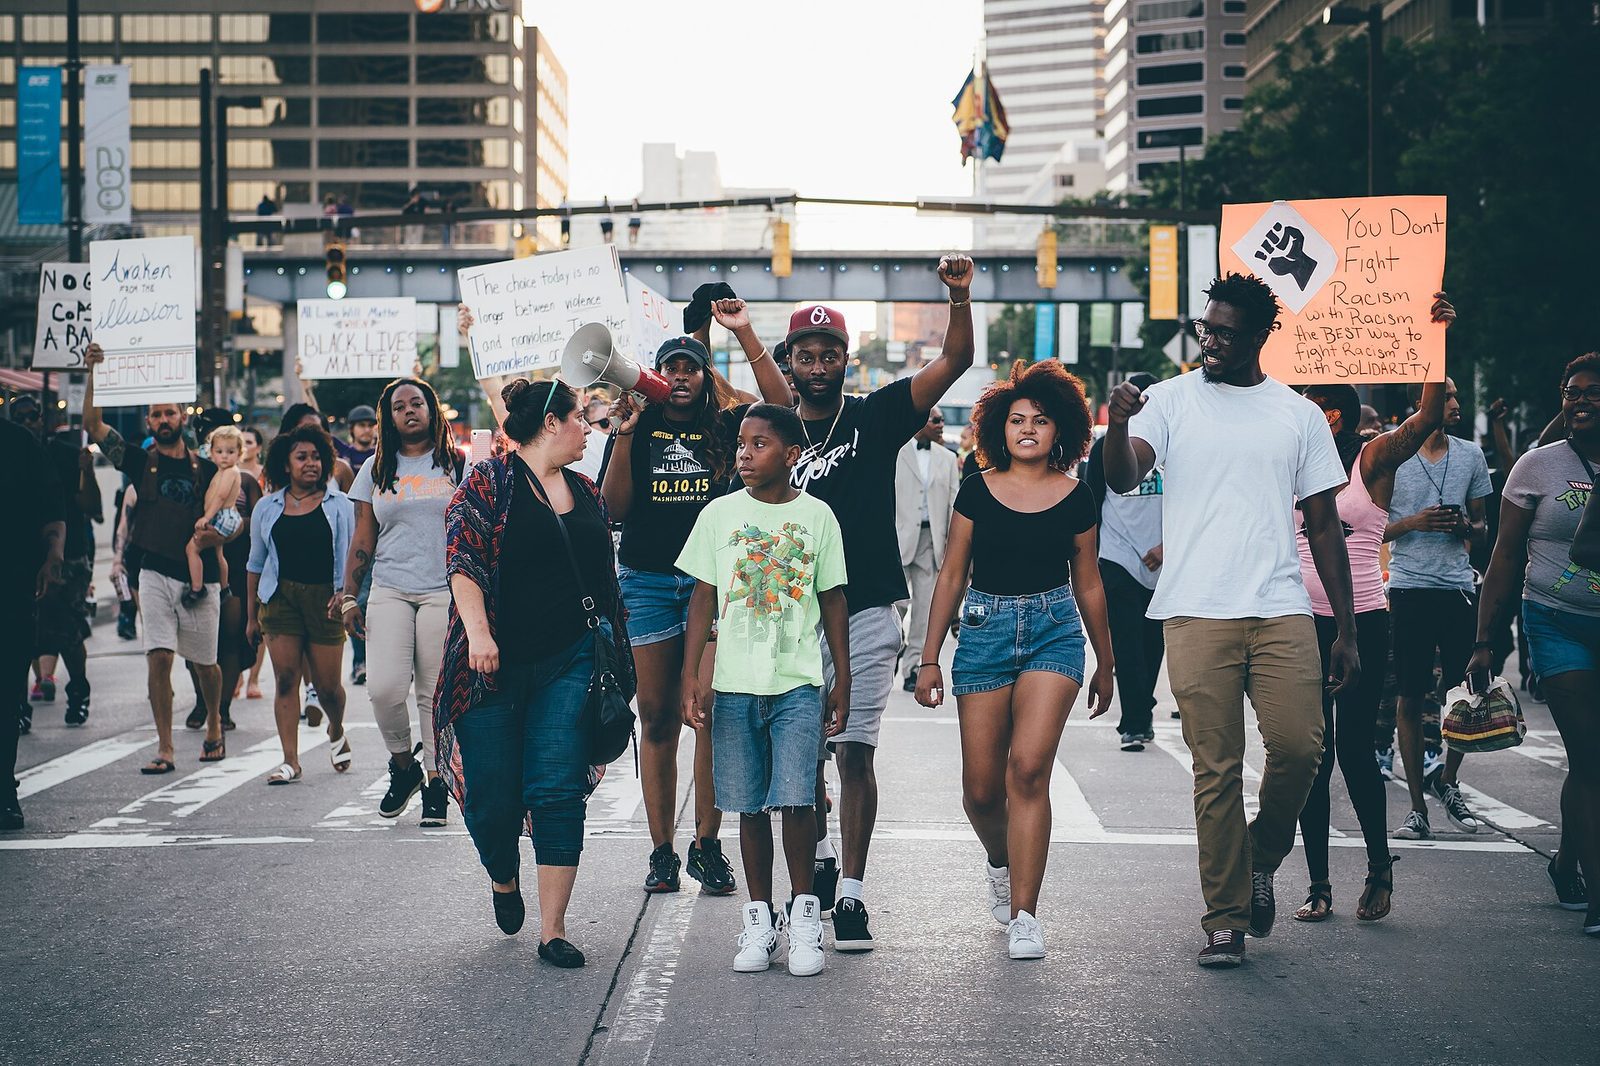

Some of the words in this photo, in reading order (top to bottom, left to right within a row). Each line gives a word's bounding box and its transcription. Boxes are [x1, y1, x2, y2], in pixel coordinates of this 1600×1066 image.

[1341, 208, 1382, 240] You
[1390, 208, 1444, 236] Dont
[101, 249, 172, 283] Awaken
[1344, 246, 1400, 283] Fight
[42, 270, 77, 294] NO
[119, 285, 138, 293] FROM
[141, 284, 155, 292] THE
[506, 274, 537, 294] choice
[542, 267, 570, 286] today
[573, 266, 582, 278] is
[588, 266, 600, 278] no
[1328, 281, 1410, 306] Racism
[94, 297, 183, 331] illusion
[514, 301, 555, 318] between
[565, 294, 601, 310] violence
[1305, 306, 1344, 322] with
[1346, 307, 1414, 326] Racism
[43, 327, 58, 351] A
[129, 337, 143, 346] OF
[304, 332, 356, 358] BLACK
[365, 330, 416, 354] LIVES
[482, 339, 502, 352] and
[1294, 325, 1316, 341] the
[1320, 326, 1363, 344] BEST
[1405, 327, 1422, 342] to
[486, 352, 540, 376] nonviolence
[548, 349, 560, 362] or
[1342, 342, 1396, 359] Racism
[324, 353, 400, 375] MATTER
[1294, 361, 1331, 375] with
[1335, 359, 1431, 381] SOLIDARITY
[652, 478, 709, 494] 10.10.15
[1569, 481, 1592, 489] TEENA
